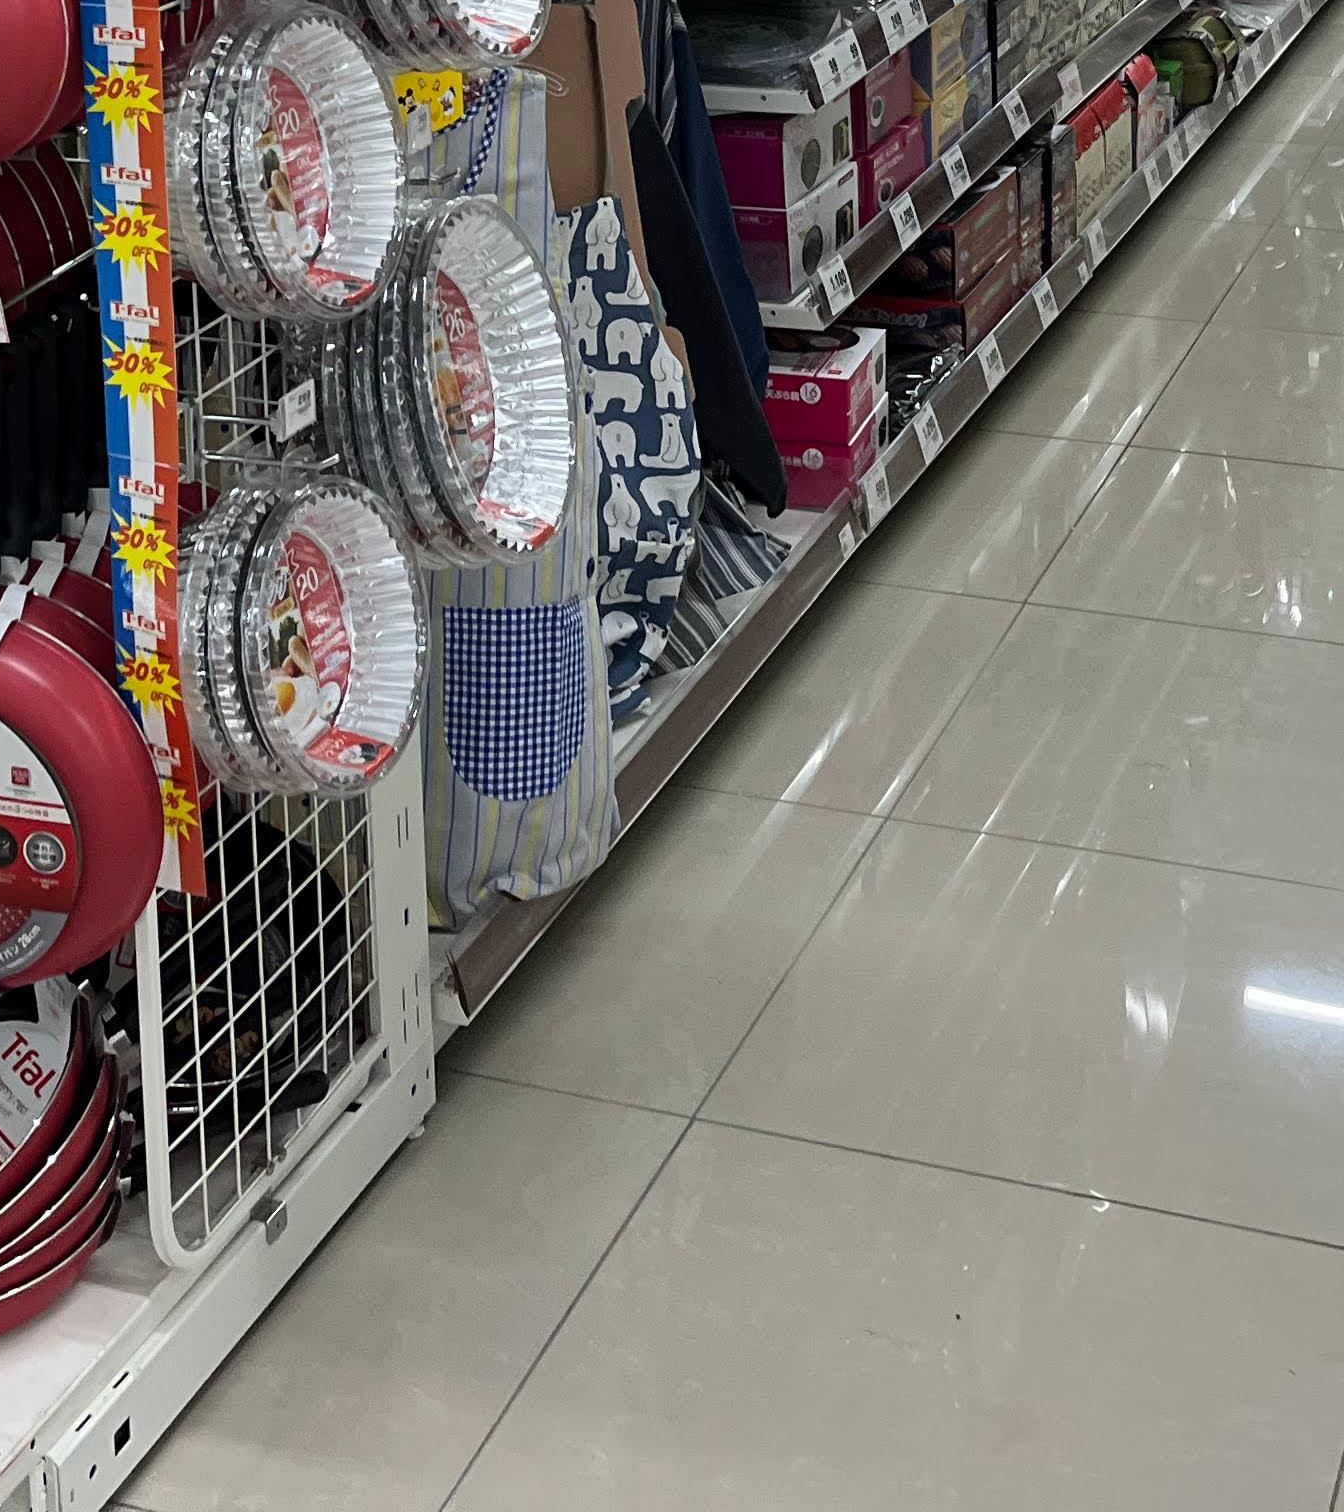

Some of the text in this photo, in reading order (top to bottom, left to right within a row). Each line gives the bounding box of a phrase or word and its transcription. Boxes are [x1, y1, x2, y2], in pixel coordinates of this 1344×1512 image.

[92, 77, 141, 99] 50%
[278, 108, 300, 135] 20
[101, 216, 149, 238] 50%
[445, 313, 467, 339] 26
[109, 352, 156, 374] 50%
[295, 569, 320, 596] 20
[0, 1032, 57, 1098] T-fal
